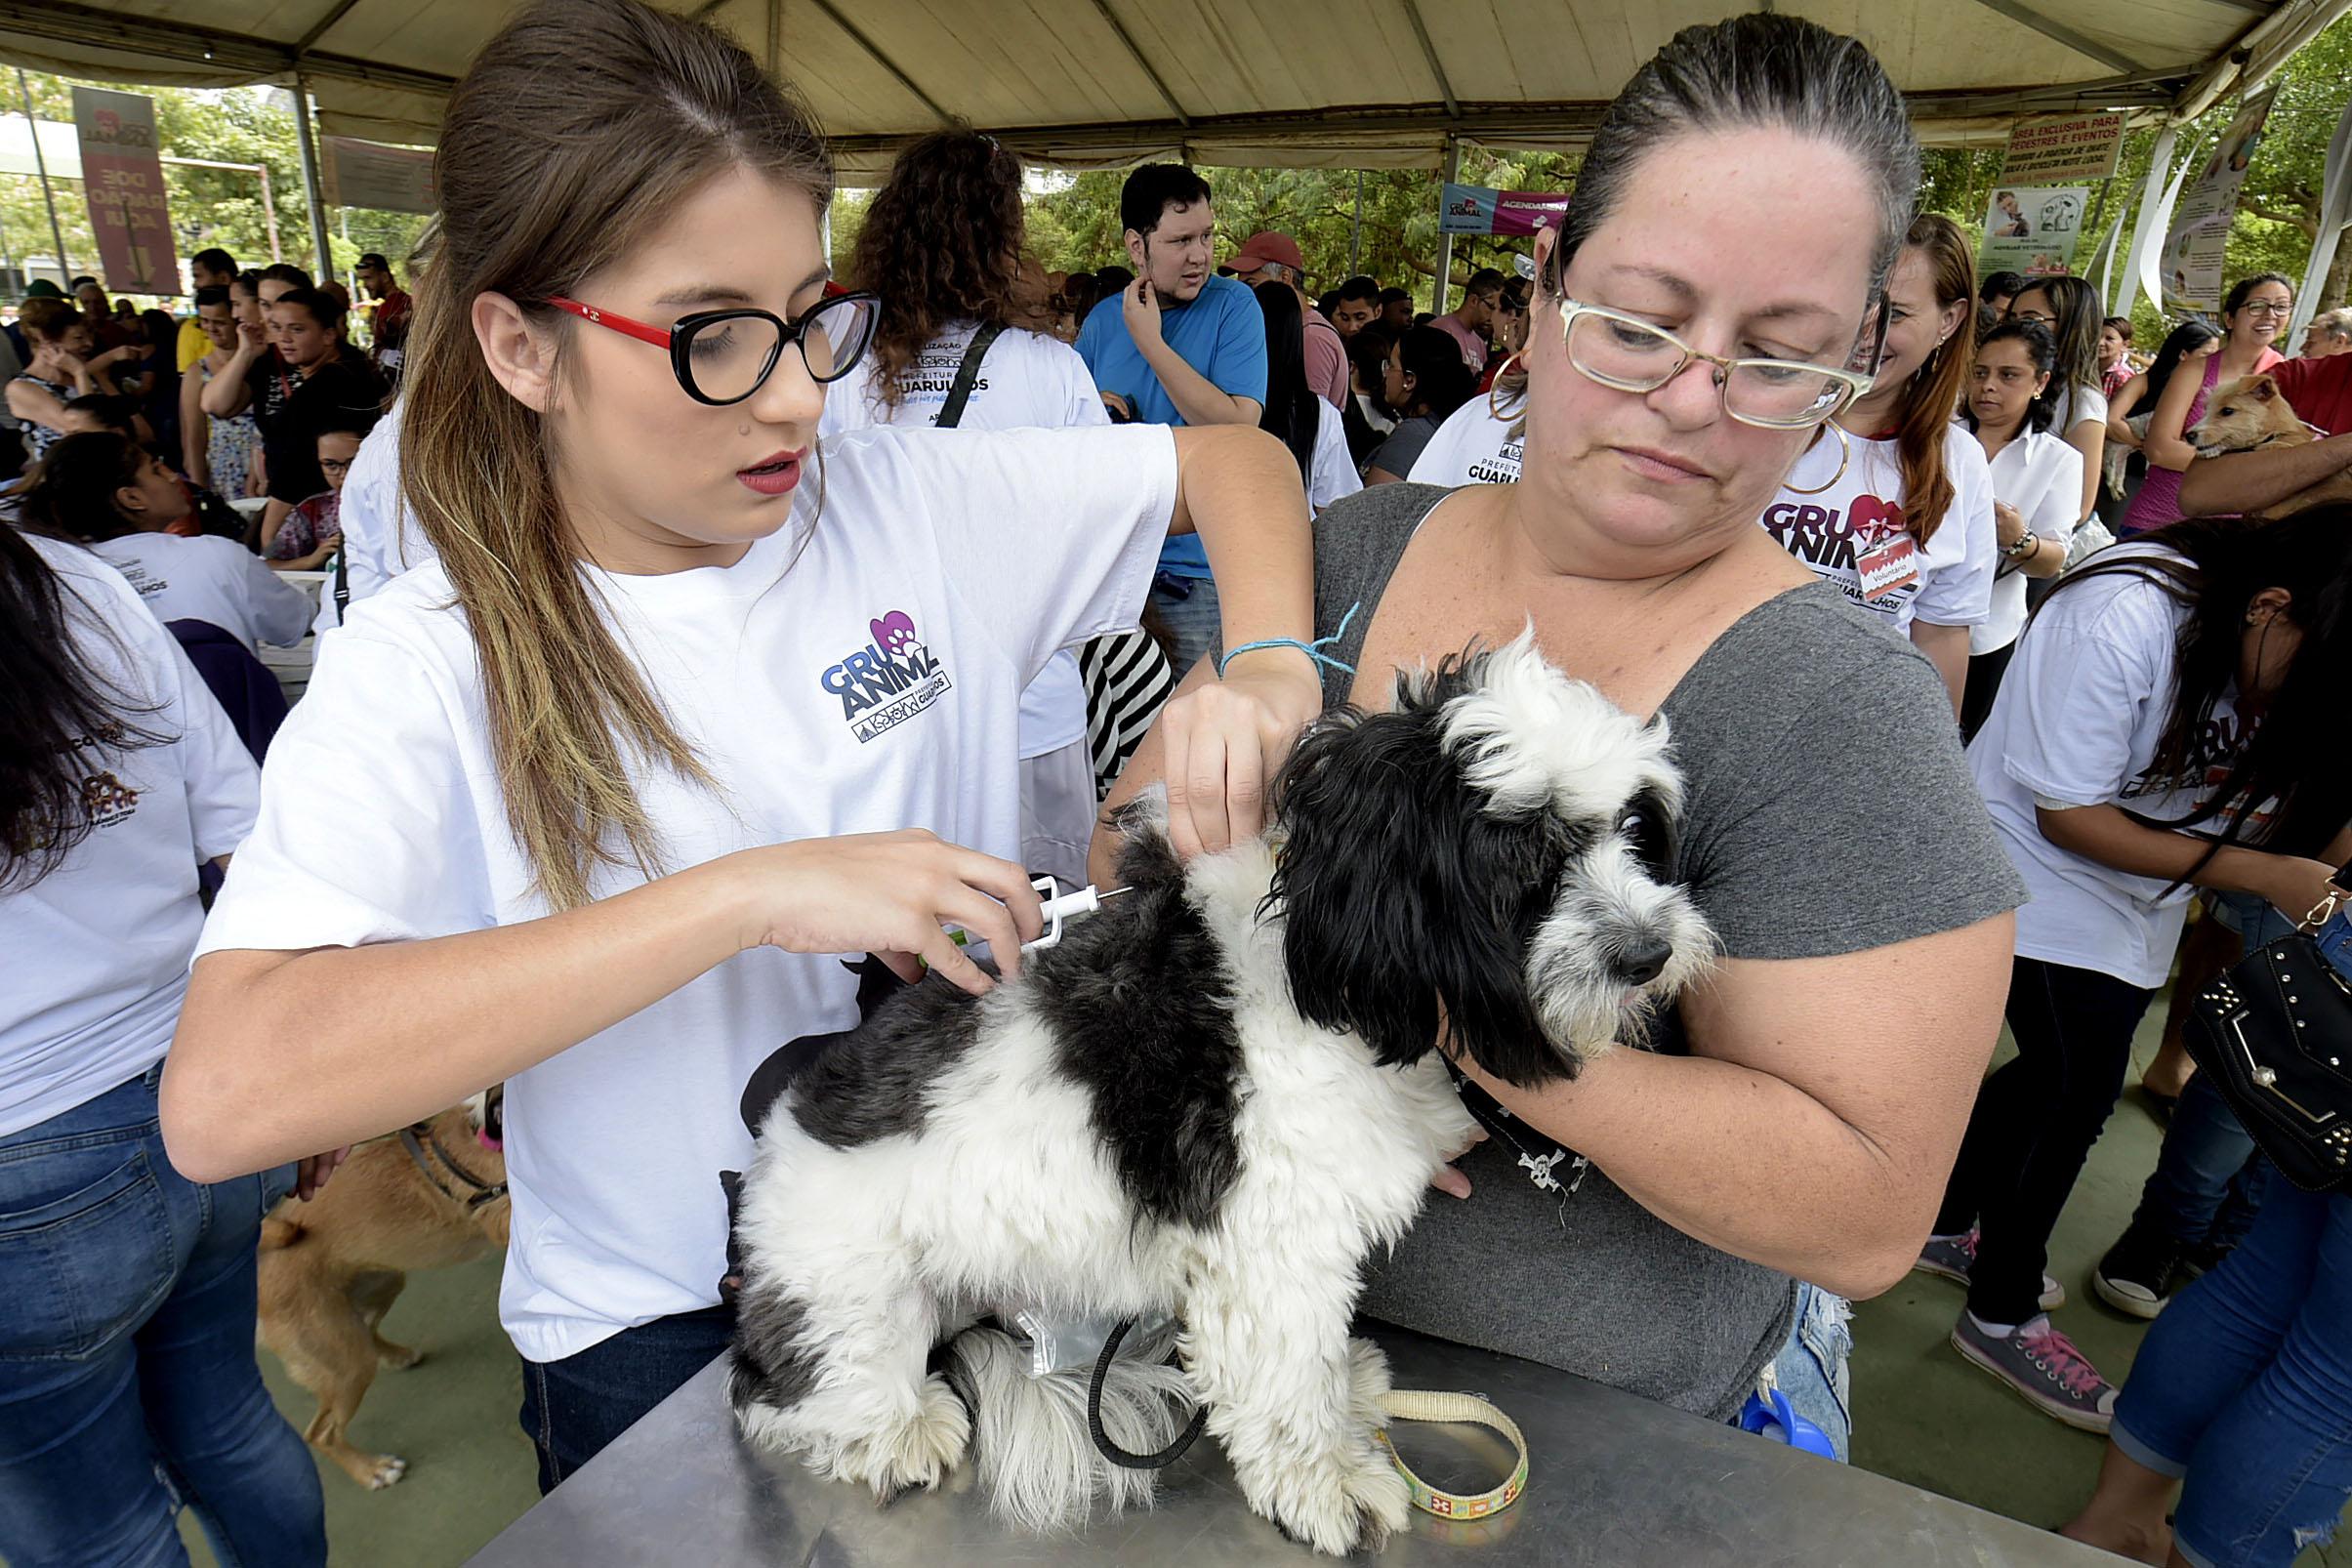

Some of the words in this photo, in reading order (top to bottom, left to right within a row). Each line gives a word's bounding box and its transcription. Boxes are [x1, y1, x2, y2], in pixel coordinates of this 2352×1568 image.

[2038, 120, 2086, 136] EXCLUSIVA
[2091, 115, 2120, 128] PARA
[2009, 136, 2058, 150] PEDESTRES
[2061, 135, 2068, 144] E
[2071, 128, 2118, 143] EVENTOS
[1503, 199, 1569, 211] AGENDAMENT
[900, 378, 989, 394] UARULOS
[1762, 503, 1855, 539] GRU
[1873, 564, 1907, 582] Voluntário
[821, 643, 894, 695] GRU
[842, 645, 940, 722] ANIML
